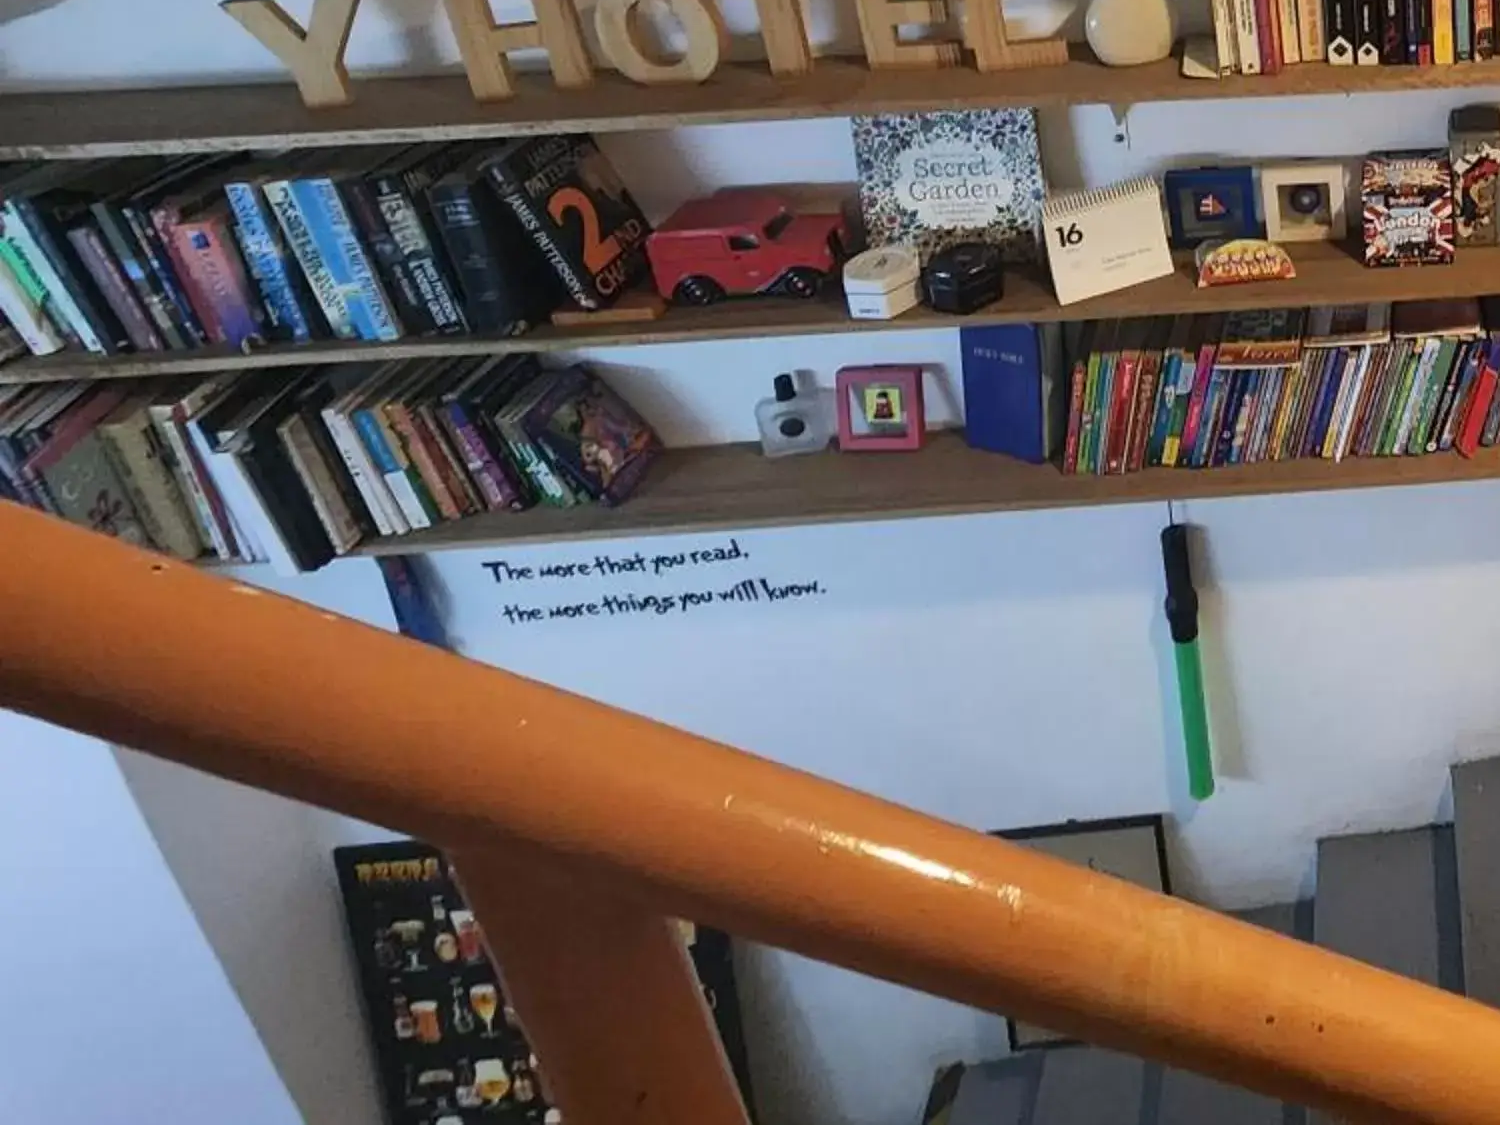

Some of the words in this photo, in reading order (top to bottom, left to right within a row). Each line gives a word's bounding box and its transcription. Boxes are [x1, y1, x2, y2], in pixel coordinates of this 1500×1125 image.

[913, 154, 993, 178] Secret
[909, 178, 999, 202] Garden
[547, 185, 622, 275] 2
[1055, 222, 1084, 248] 16
[481, 560, 535, 584] The
[538, 559, 592, 579] more
[593, 553, 648, 576] that
[648, 551, 686, 578] you
[502, 602, 544, 626] the
[548, 600, 600, 621] more
[600, 593, 676, 616] things
[677, 588, 714, 613] you
[717, 578, 759, 603] will
